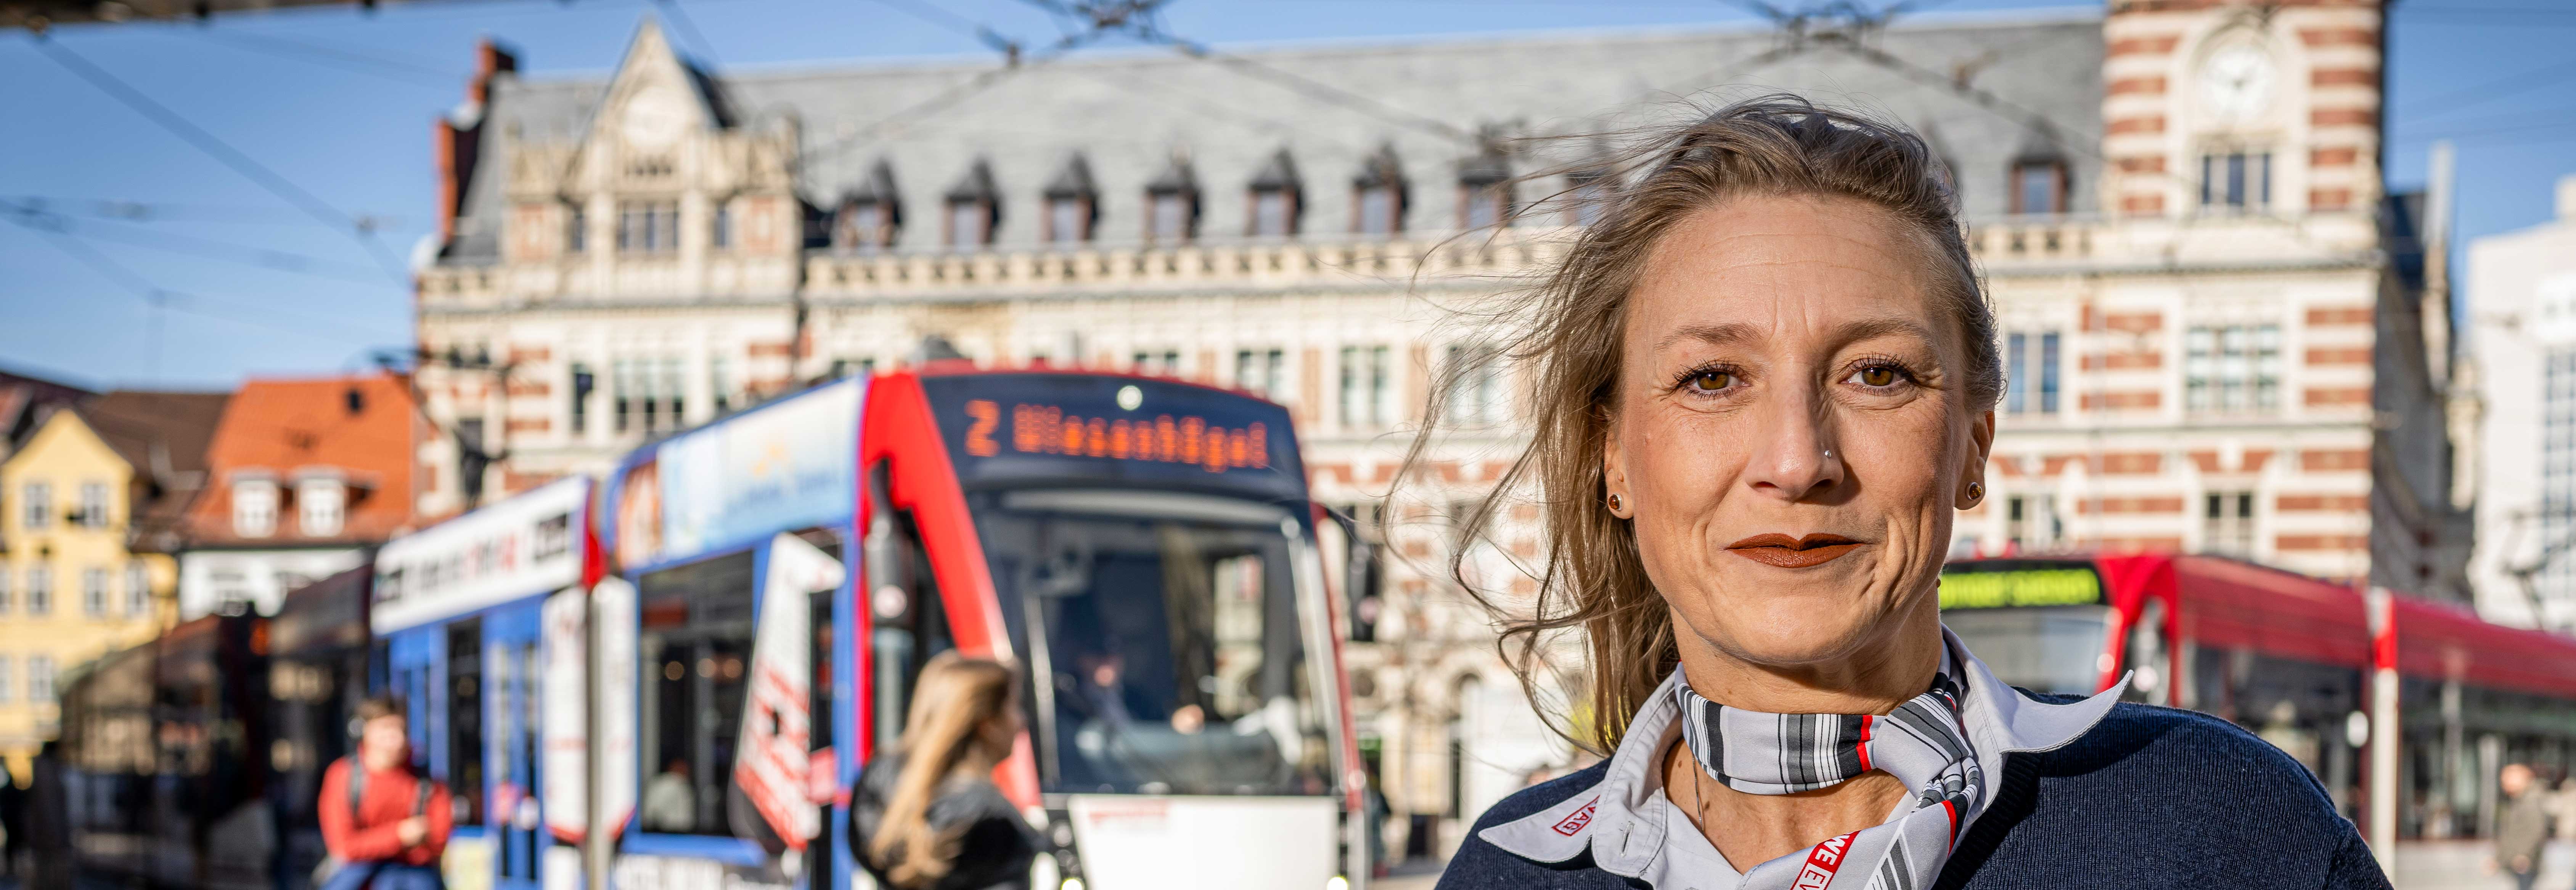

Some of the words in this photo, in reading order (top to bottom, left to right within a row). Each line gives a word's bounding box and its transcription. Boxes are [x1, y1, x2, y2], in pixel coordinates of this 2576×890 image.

[964, 399, 1001, 456] 2
[1563, 799, 1598, 830] VAG
[1815, 831, 1853, 865] WE
